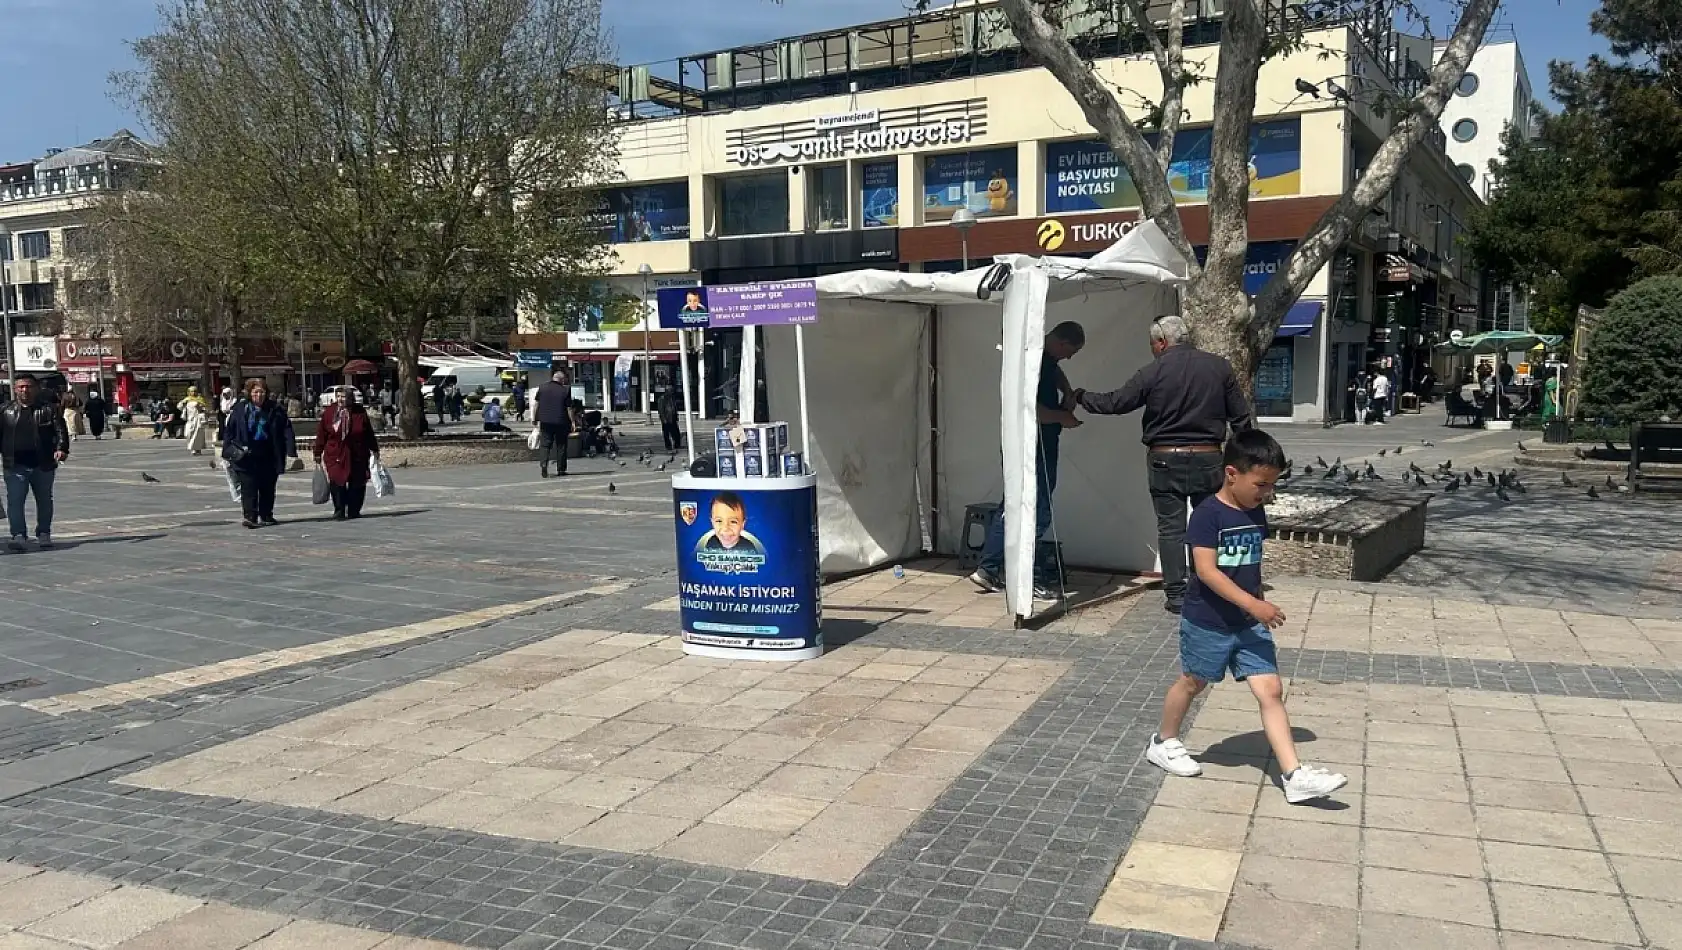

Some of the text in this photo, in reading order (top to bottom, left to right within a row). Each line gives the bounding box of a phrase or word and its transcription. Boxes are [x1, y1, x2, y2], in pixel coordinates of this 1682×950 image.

[852, 115, 972, 153] kahvecisi
[1059, 154, 1075, 167] EV
[1058, 166, 1119, 183] BAŞVURU
[1058, 181, 1115, 197] NOKTASI
[681, 582, 795, 598] YAŞAMAK İSTİYOR!
[716, 602, 748, 613] TUTAR
[750, 603, 800, 614] MISINIZ?
